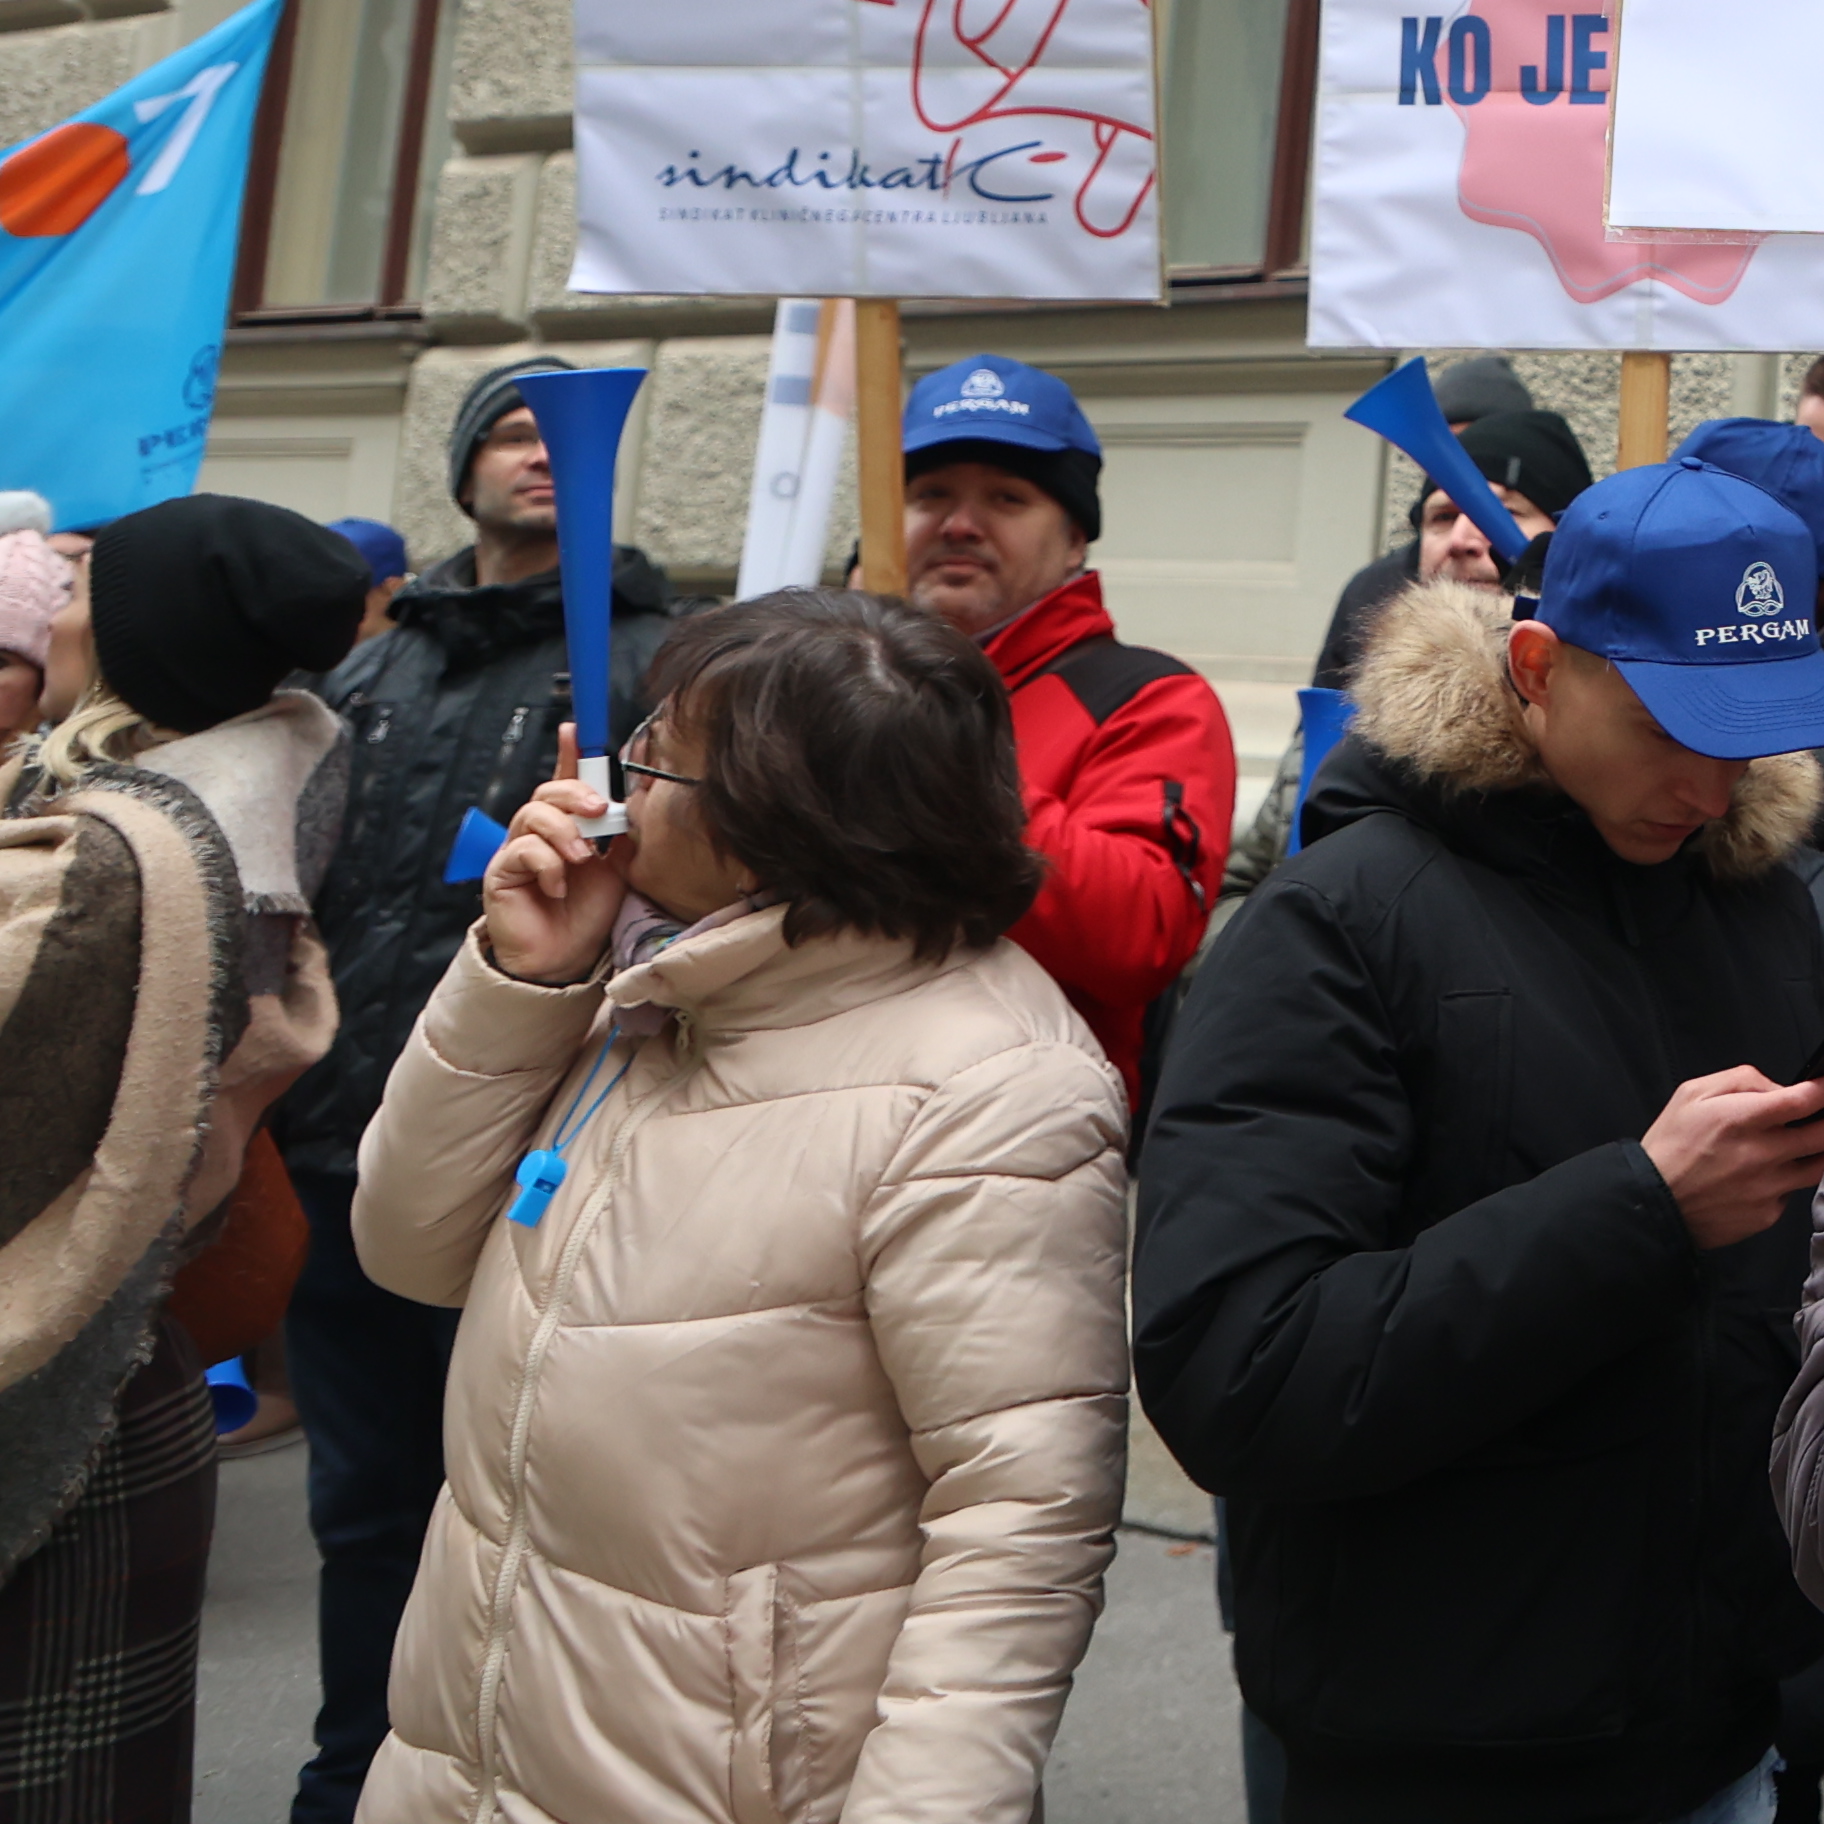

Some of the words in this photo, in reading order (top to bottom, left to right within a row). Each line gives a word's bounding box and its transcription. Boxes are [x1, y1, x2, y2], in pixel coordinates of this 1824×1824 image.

[1399, 15, 1491, 106] KO
[1520, 14, 1609, 105] JE
[933, 398, 1030, 418] PERGAM
[1695, 619, 1810, 646] PERGAM
